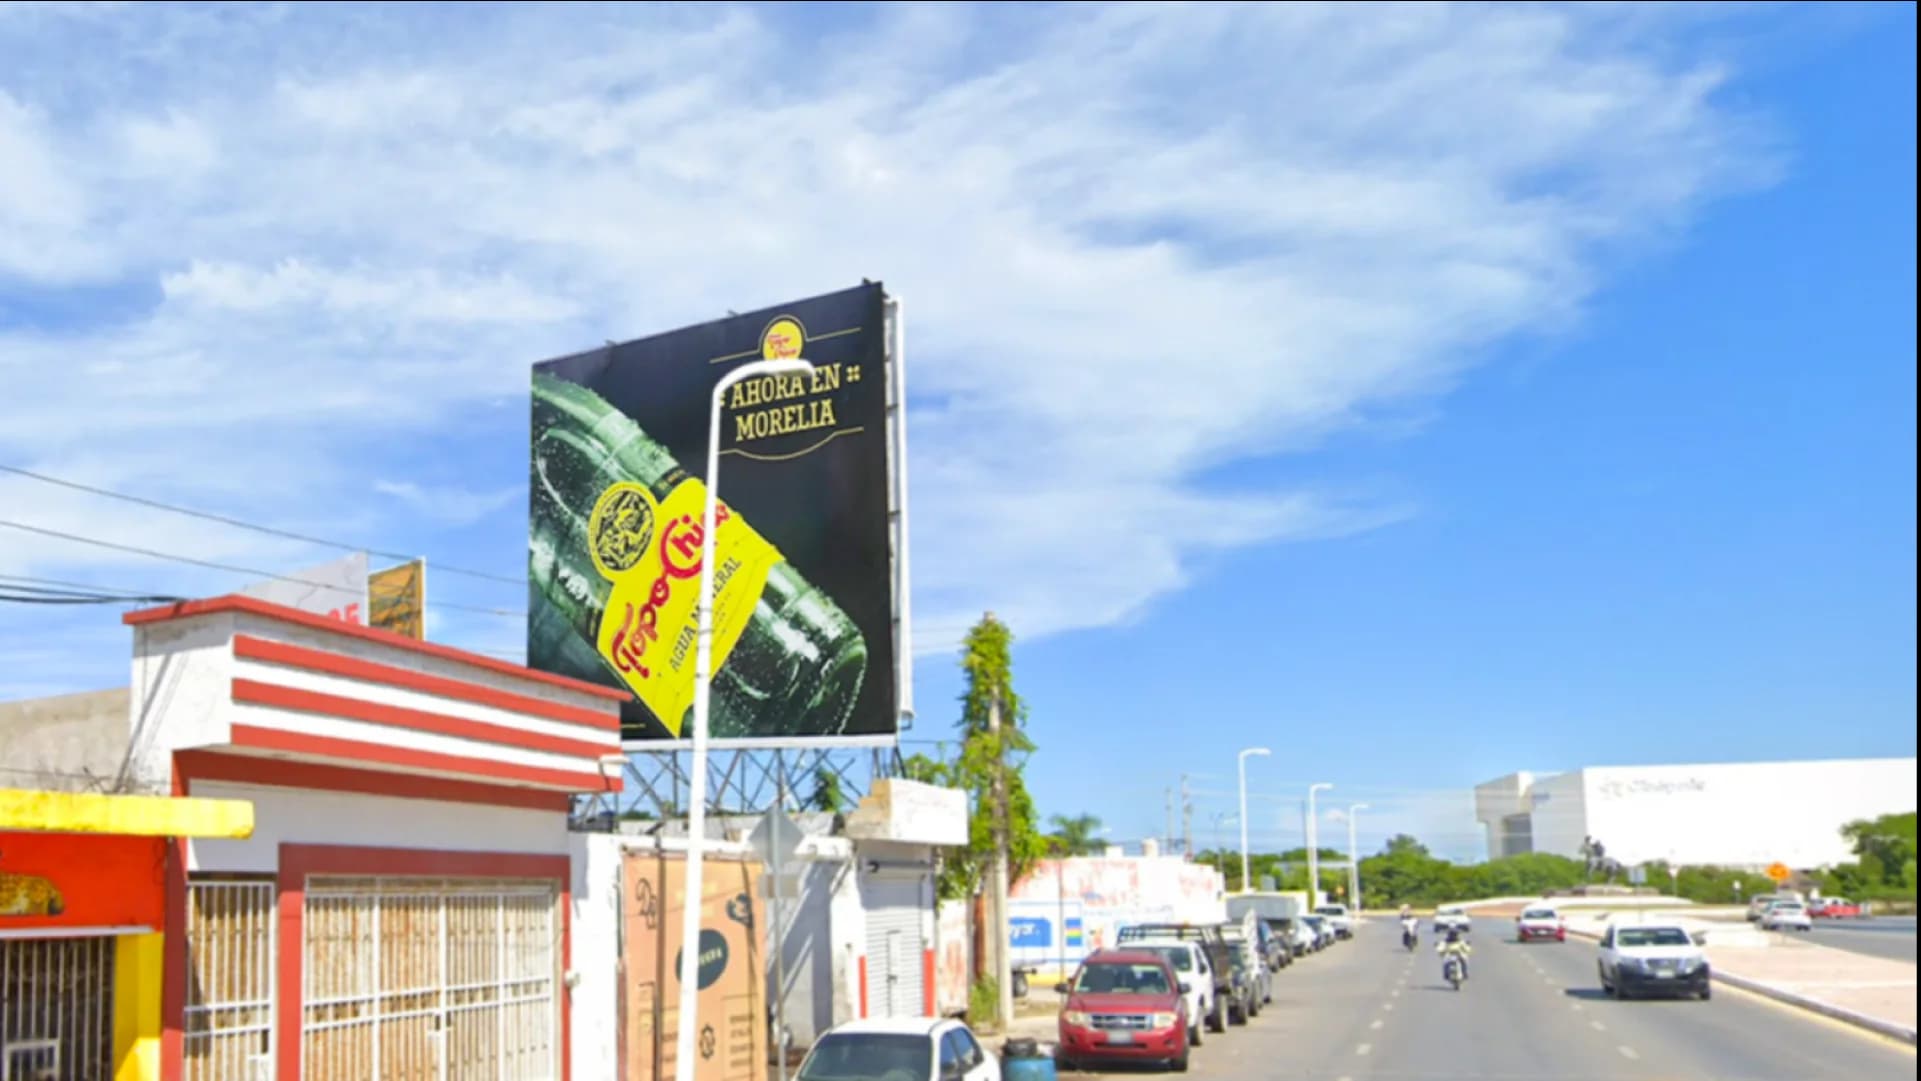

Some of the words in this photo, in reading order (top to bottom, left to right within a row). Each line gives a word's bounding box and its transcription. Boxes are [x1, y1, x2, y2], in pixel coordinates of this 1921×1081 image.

[730, 373, 807, 410] AHORA
[809, 362, 842, 394] EN
[735, 398, 837, 442] MORELIA
[611, 576, 670, 679] Topo
[670, 624, 698, 673] AGUA
